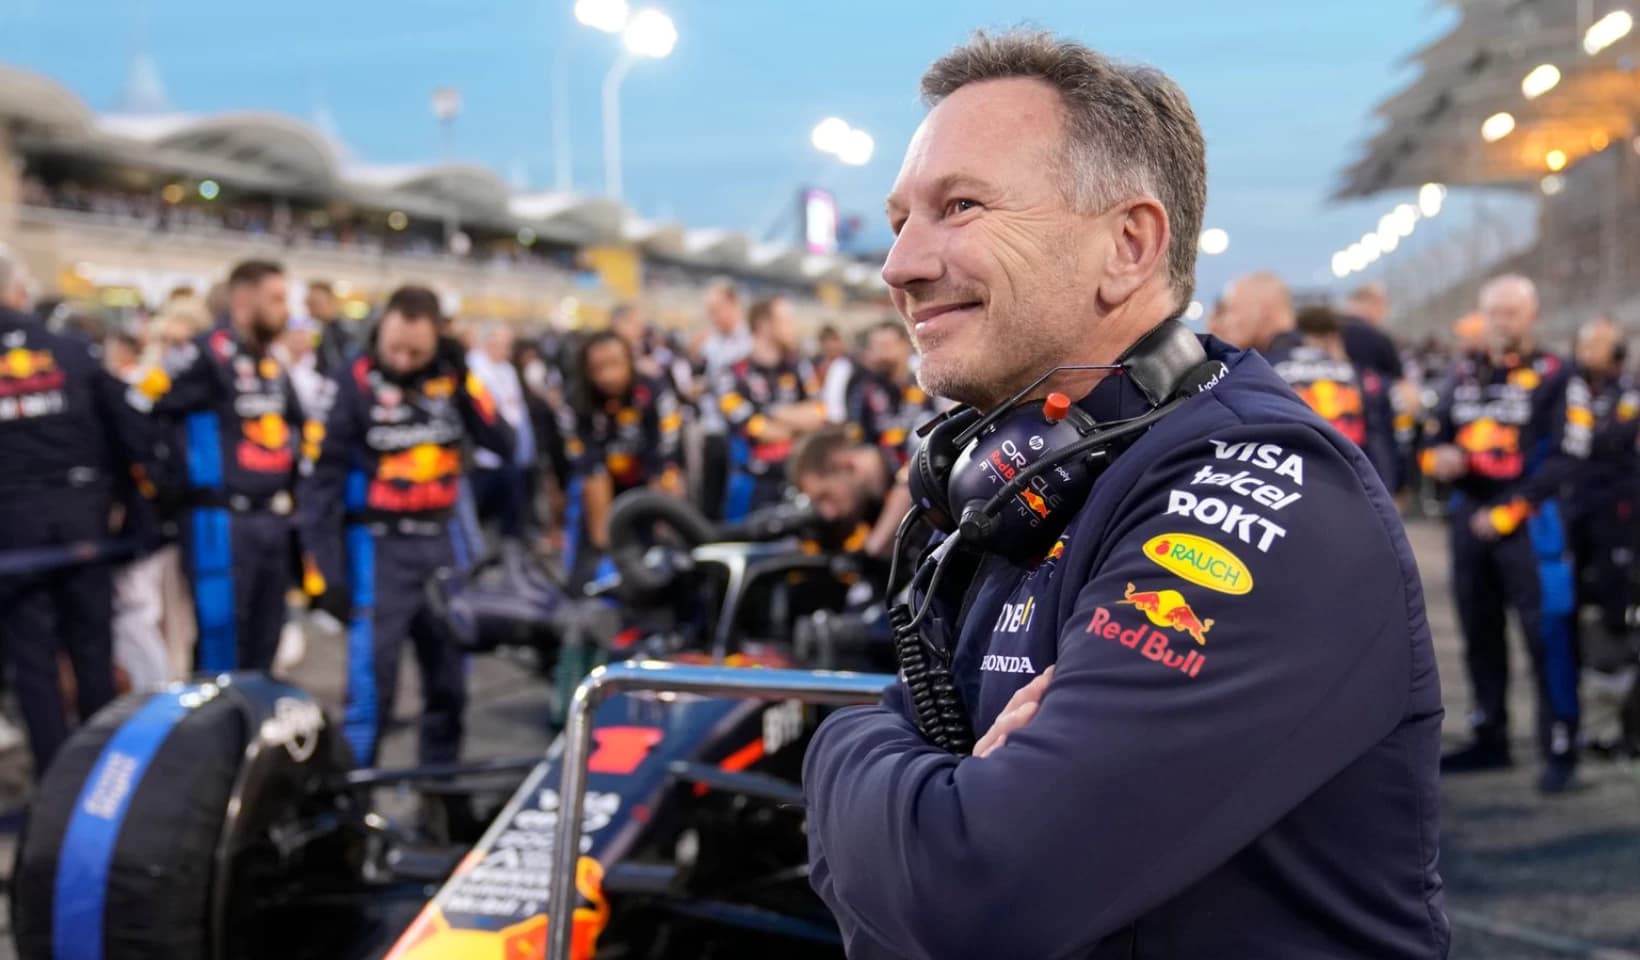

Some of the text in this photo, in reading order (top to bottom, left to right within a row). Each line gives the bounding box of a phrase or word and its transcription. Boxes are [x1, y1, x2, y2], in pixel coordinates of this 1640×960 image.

[980, 461, 1039, 527] RAING
[1001, 440, 1061, 507] ORCLE
[1208, 439, 1303, 486] VISA
[1162, 489, 1287, 553] ROKT
[1190, 465, 1302, 530] telcel
[1171, 543, 1240, 586] RAUCH
[1086, 607, 1206, 678] Red Bull
